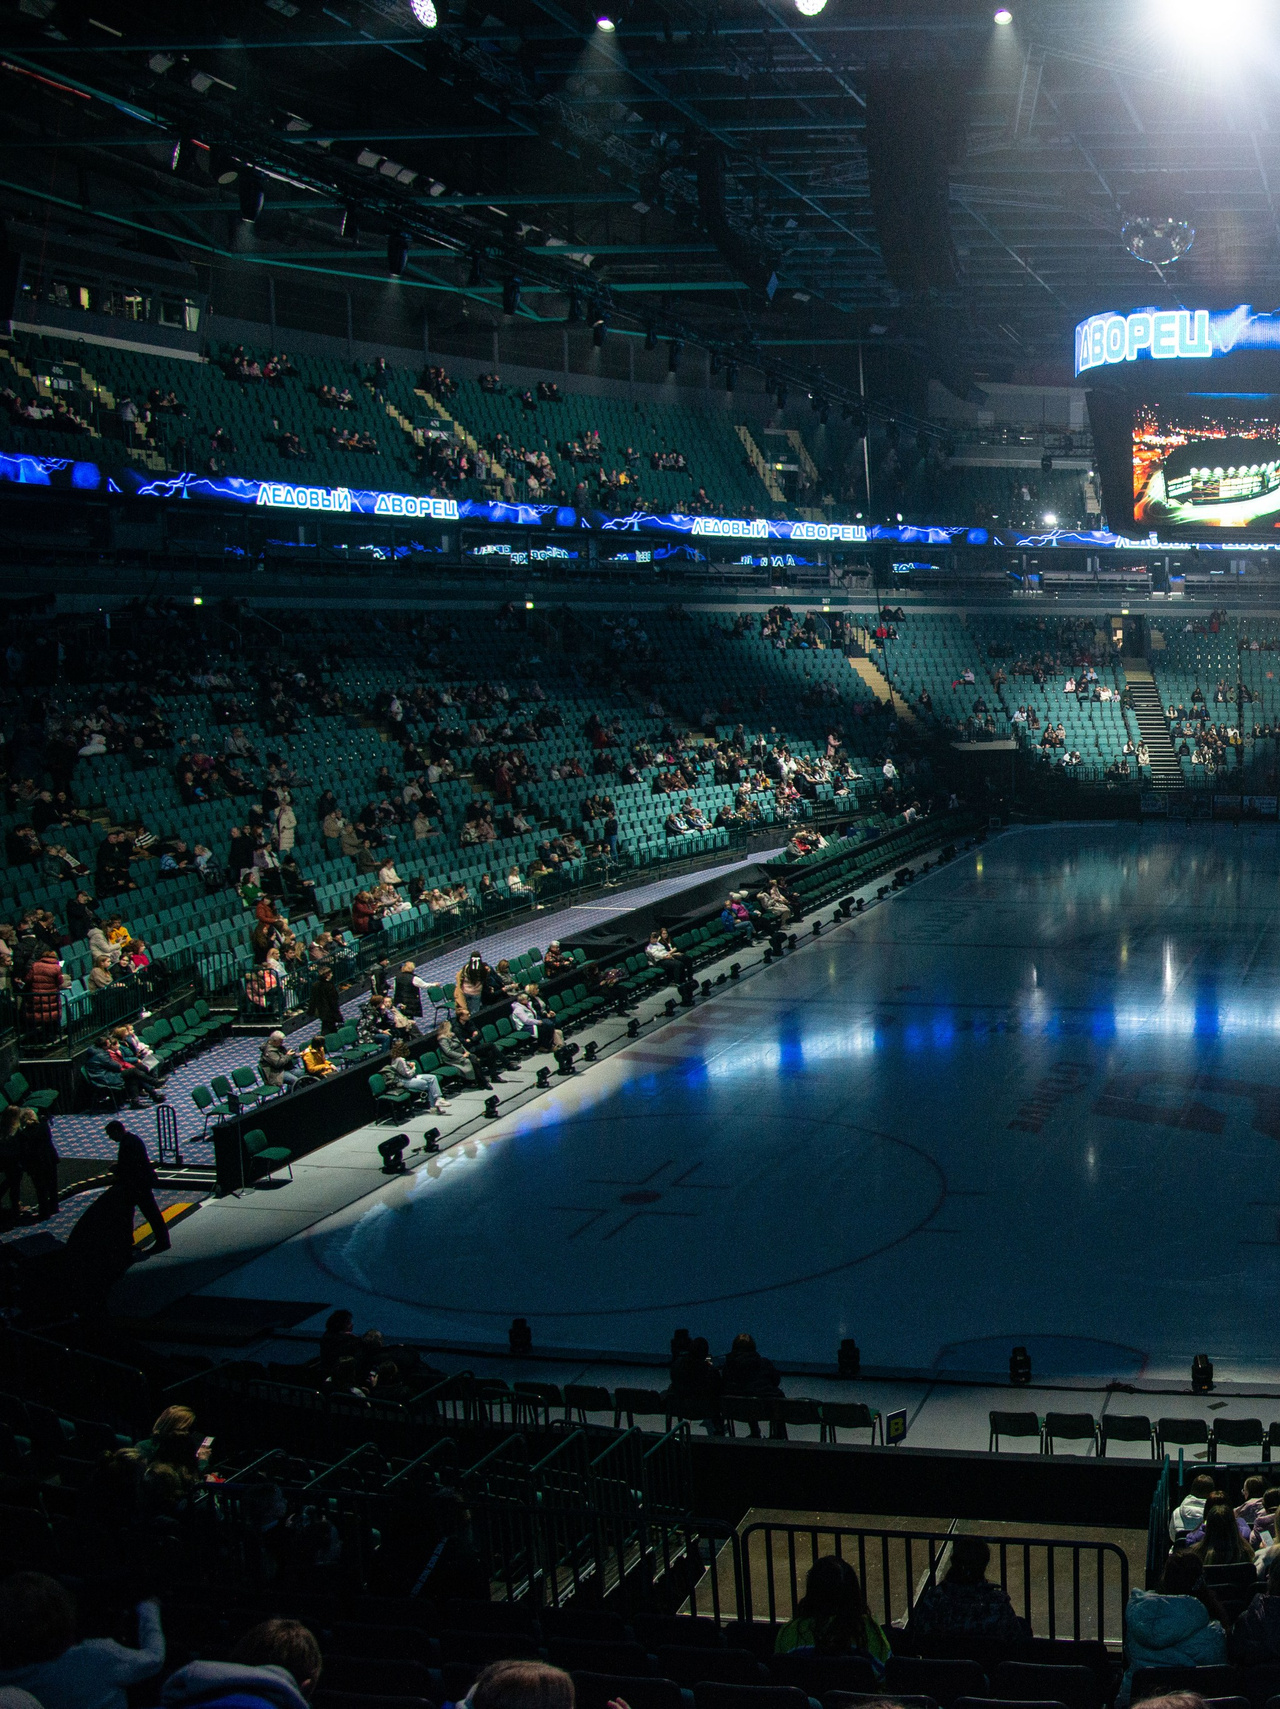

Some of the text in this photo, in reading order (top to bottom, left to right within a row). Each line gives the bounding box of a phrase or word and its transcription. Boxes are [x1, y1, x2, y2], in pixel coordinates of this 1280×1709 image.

[1080, 310, 1212, 371] ДВОРЕЦ
[257, 484, 459, 519] ЛЕДОВЫЙ ДВОРЕЦ
[692, 518, 867, 541] ЛЕДОВЫЙ ДВОРЕЦ
